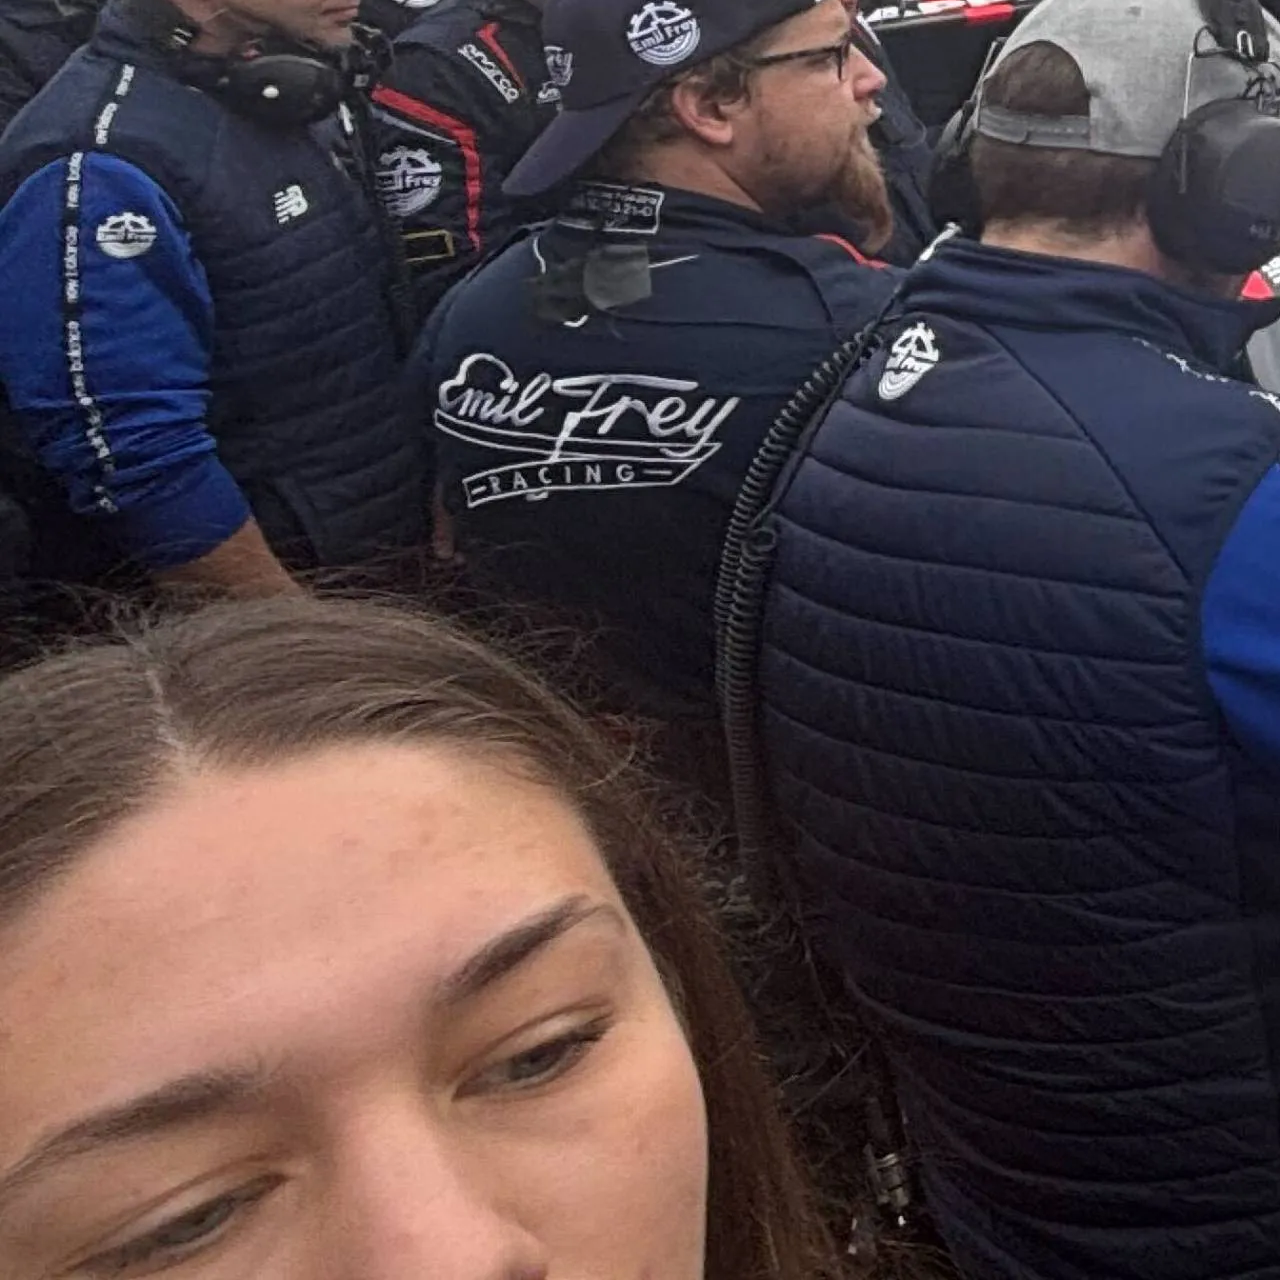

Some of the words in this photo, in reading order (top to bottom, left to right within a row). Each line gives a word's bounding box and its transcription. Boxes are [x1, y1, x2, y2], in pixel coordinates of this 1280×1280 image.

[438, 352, 551, 427] Emil
[552, 374, 742, 463] Frey
[488, 465, 636, 496] RACING
